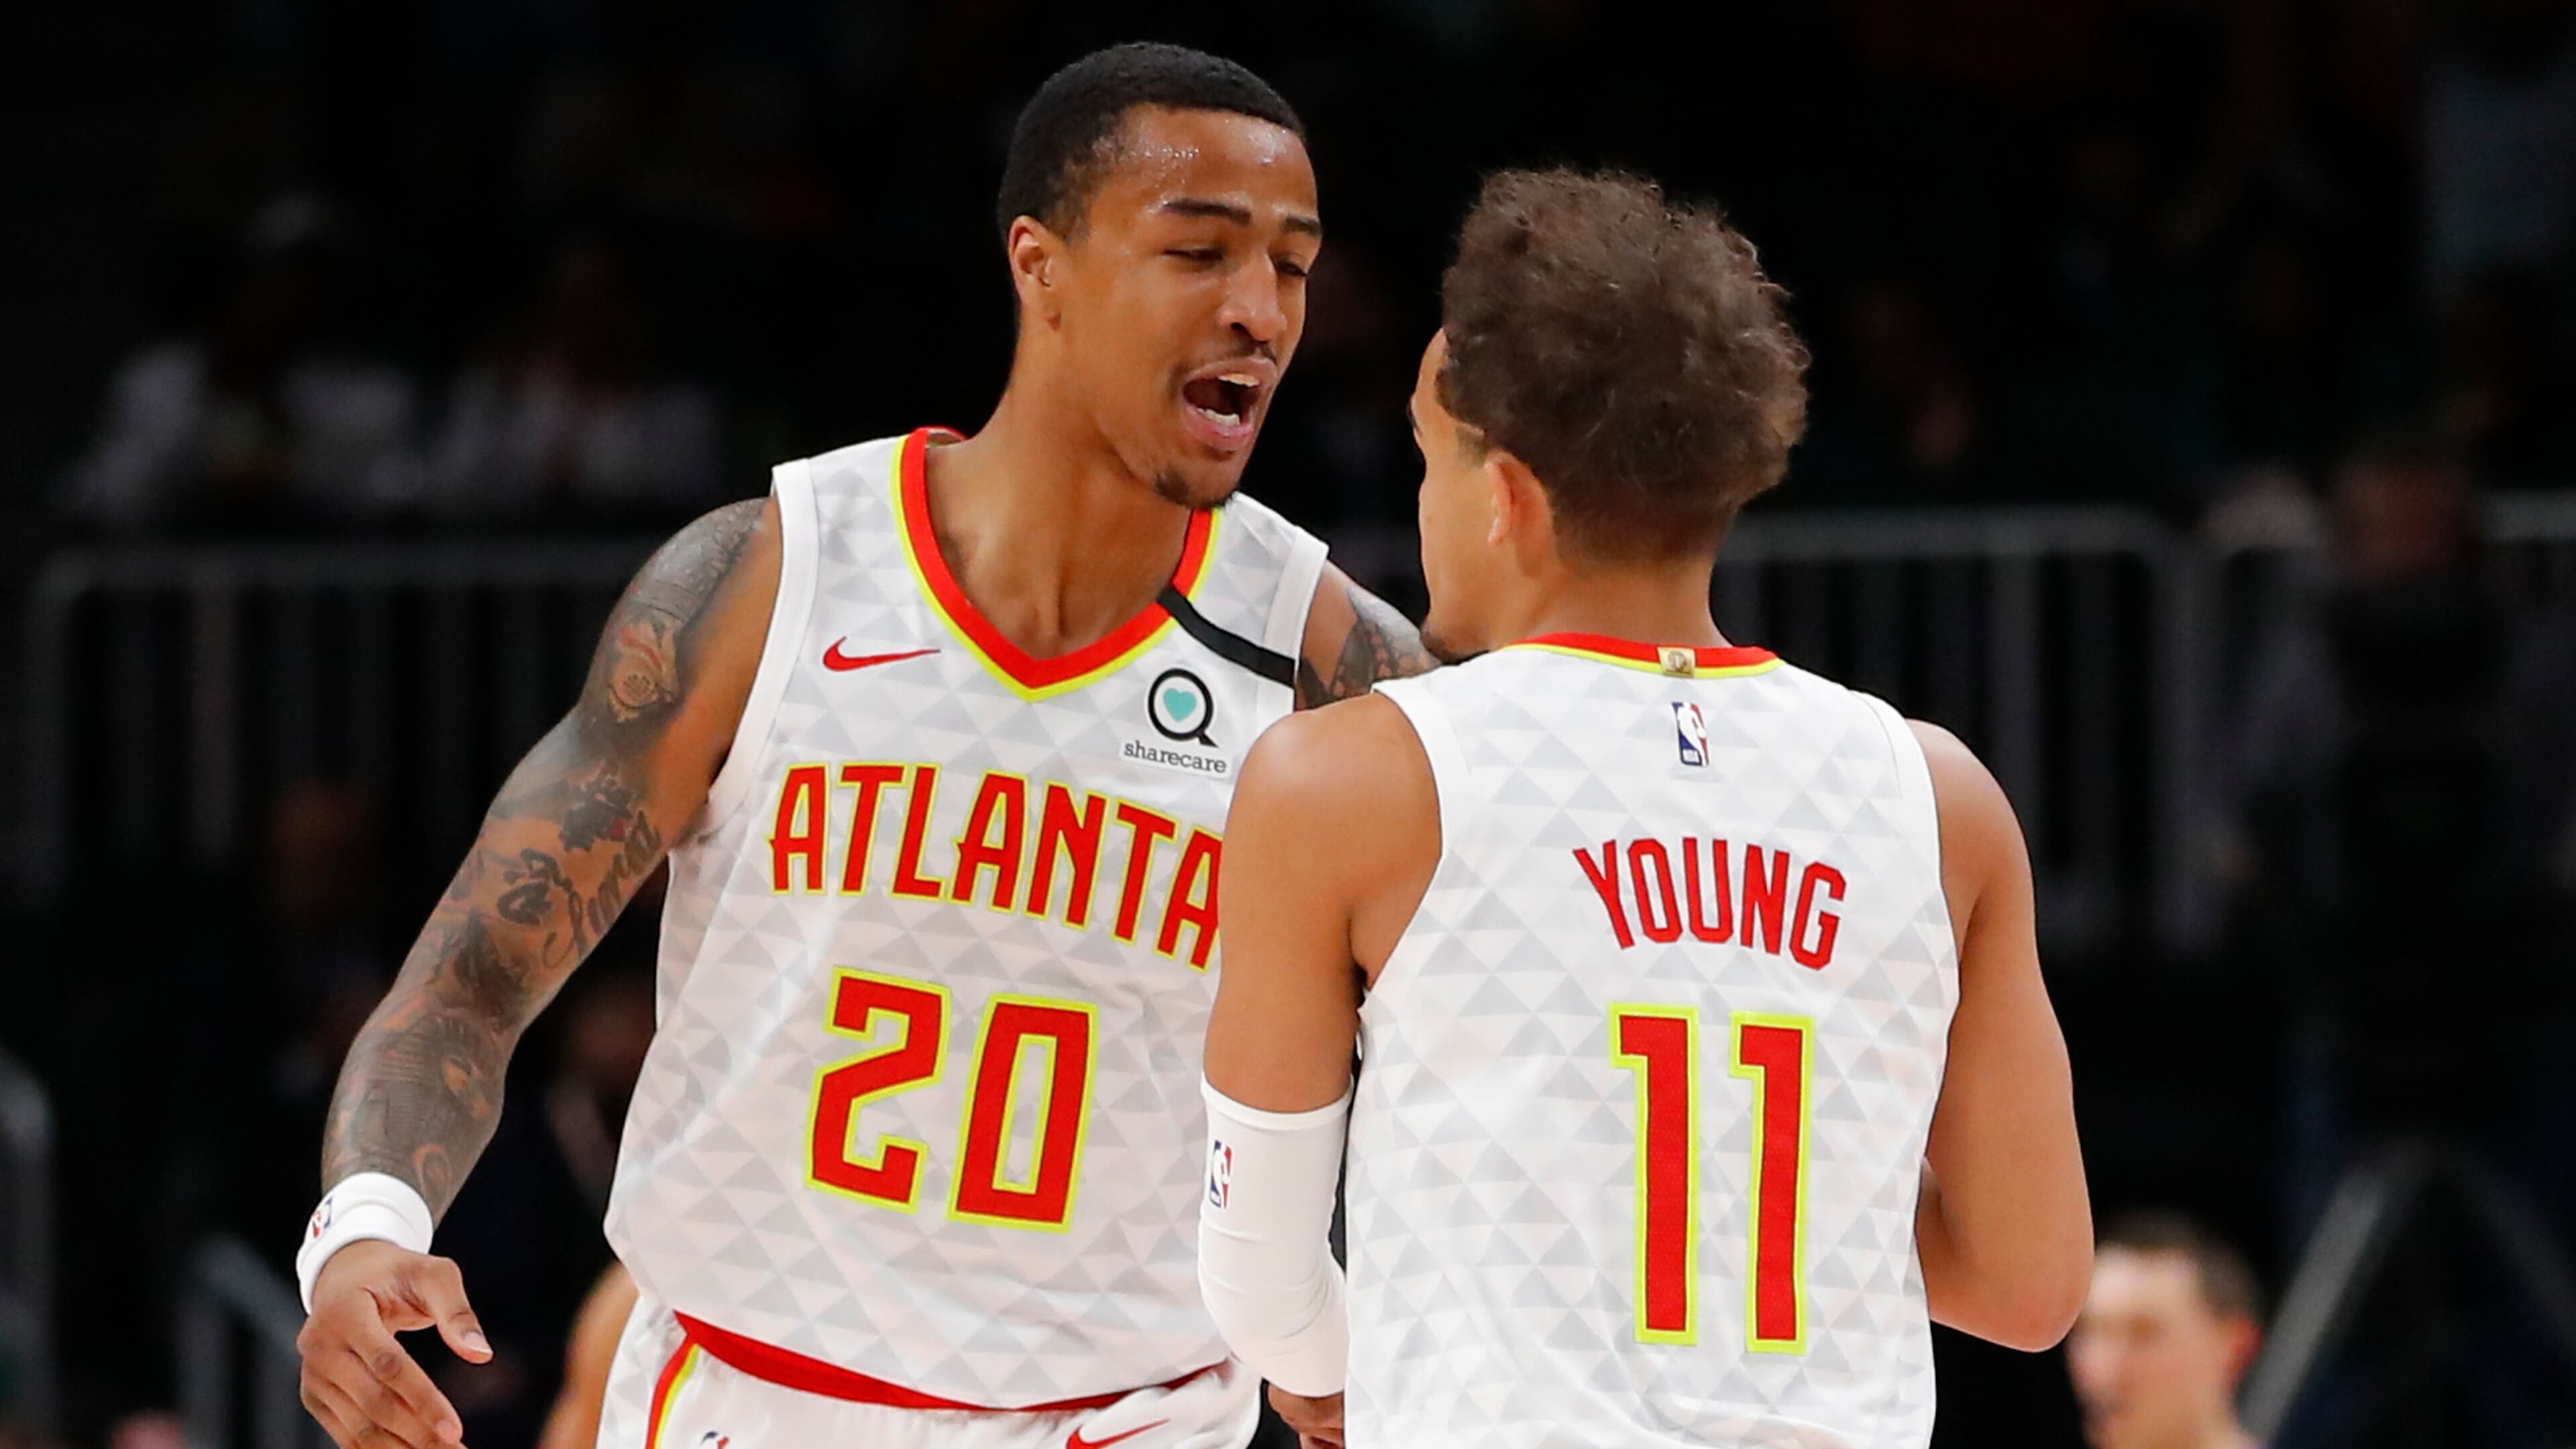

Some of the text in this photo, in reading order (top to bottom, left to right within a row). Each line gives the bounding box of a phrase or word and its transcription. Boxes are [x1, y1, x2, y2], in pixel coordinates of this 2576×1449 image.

[1123, 739, 1227, 773] sharecare
[769, 762, 1224, 974] ATLANTA
[1572, 837, 1847, 971] YOUNG
[804, 965, 1101, 1234] 20
[1607, 1002, 1816, 1356] 11
